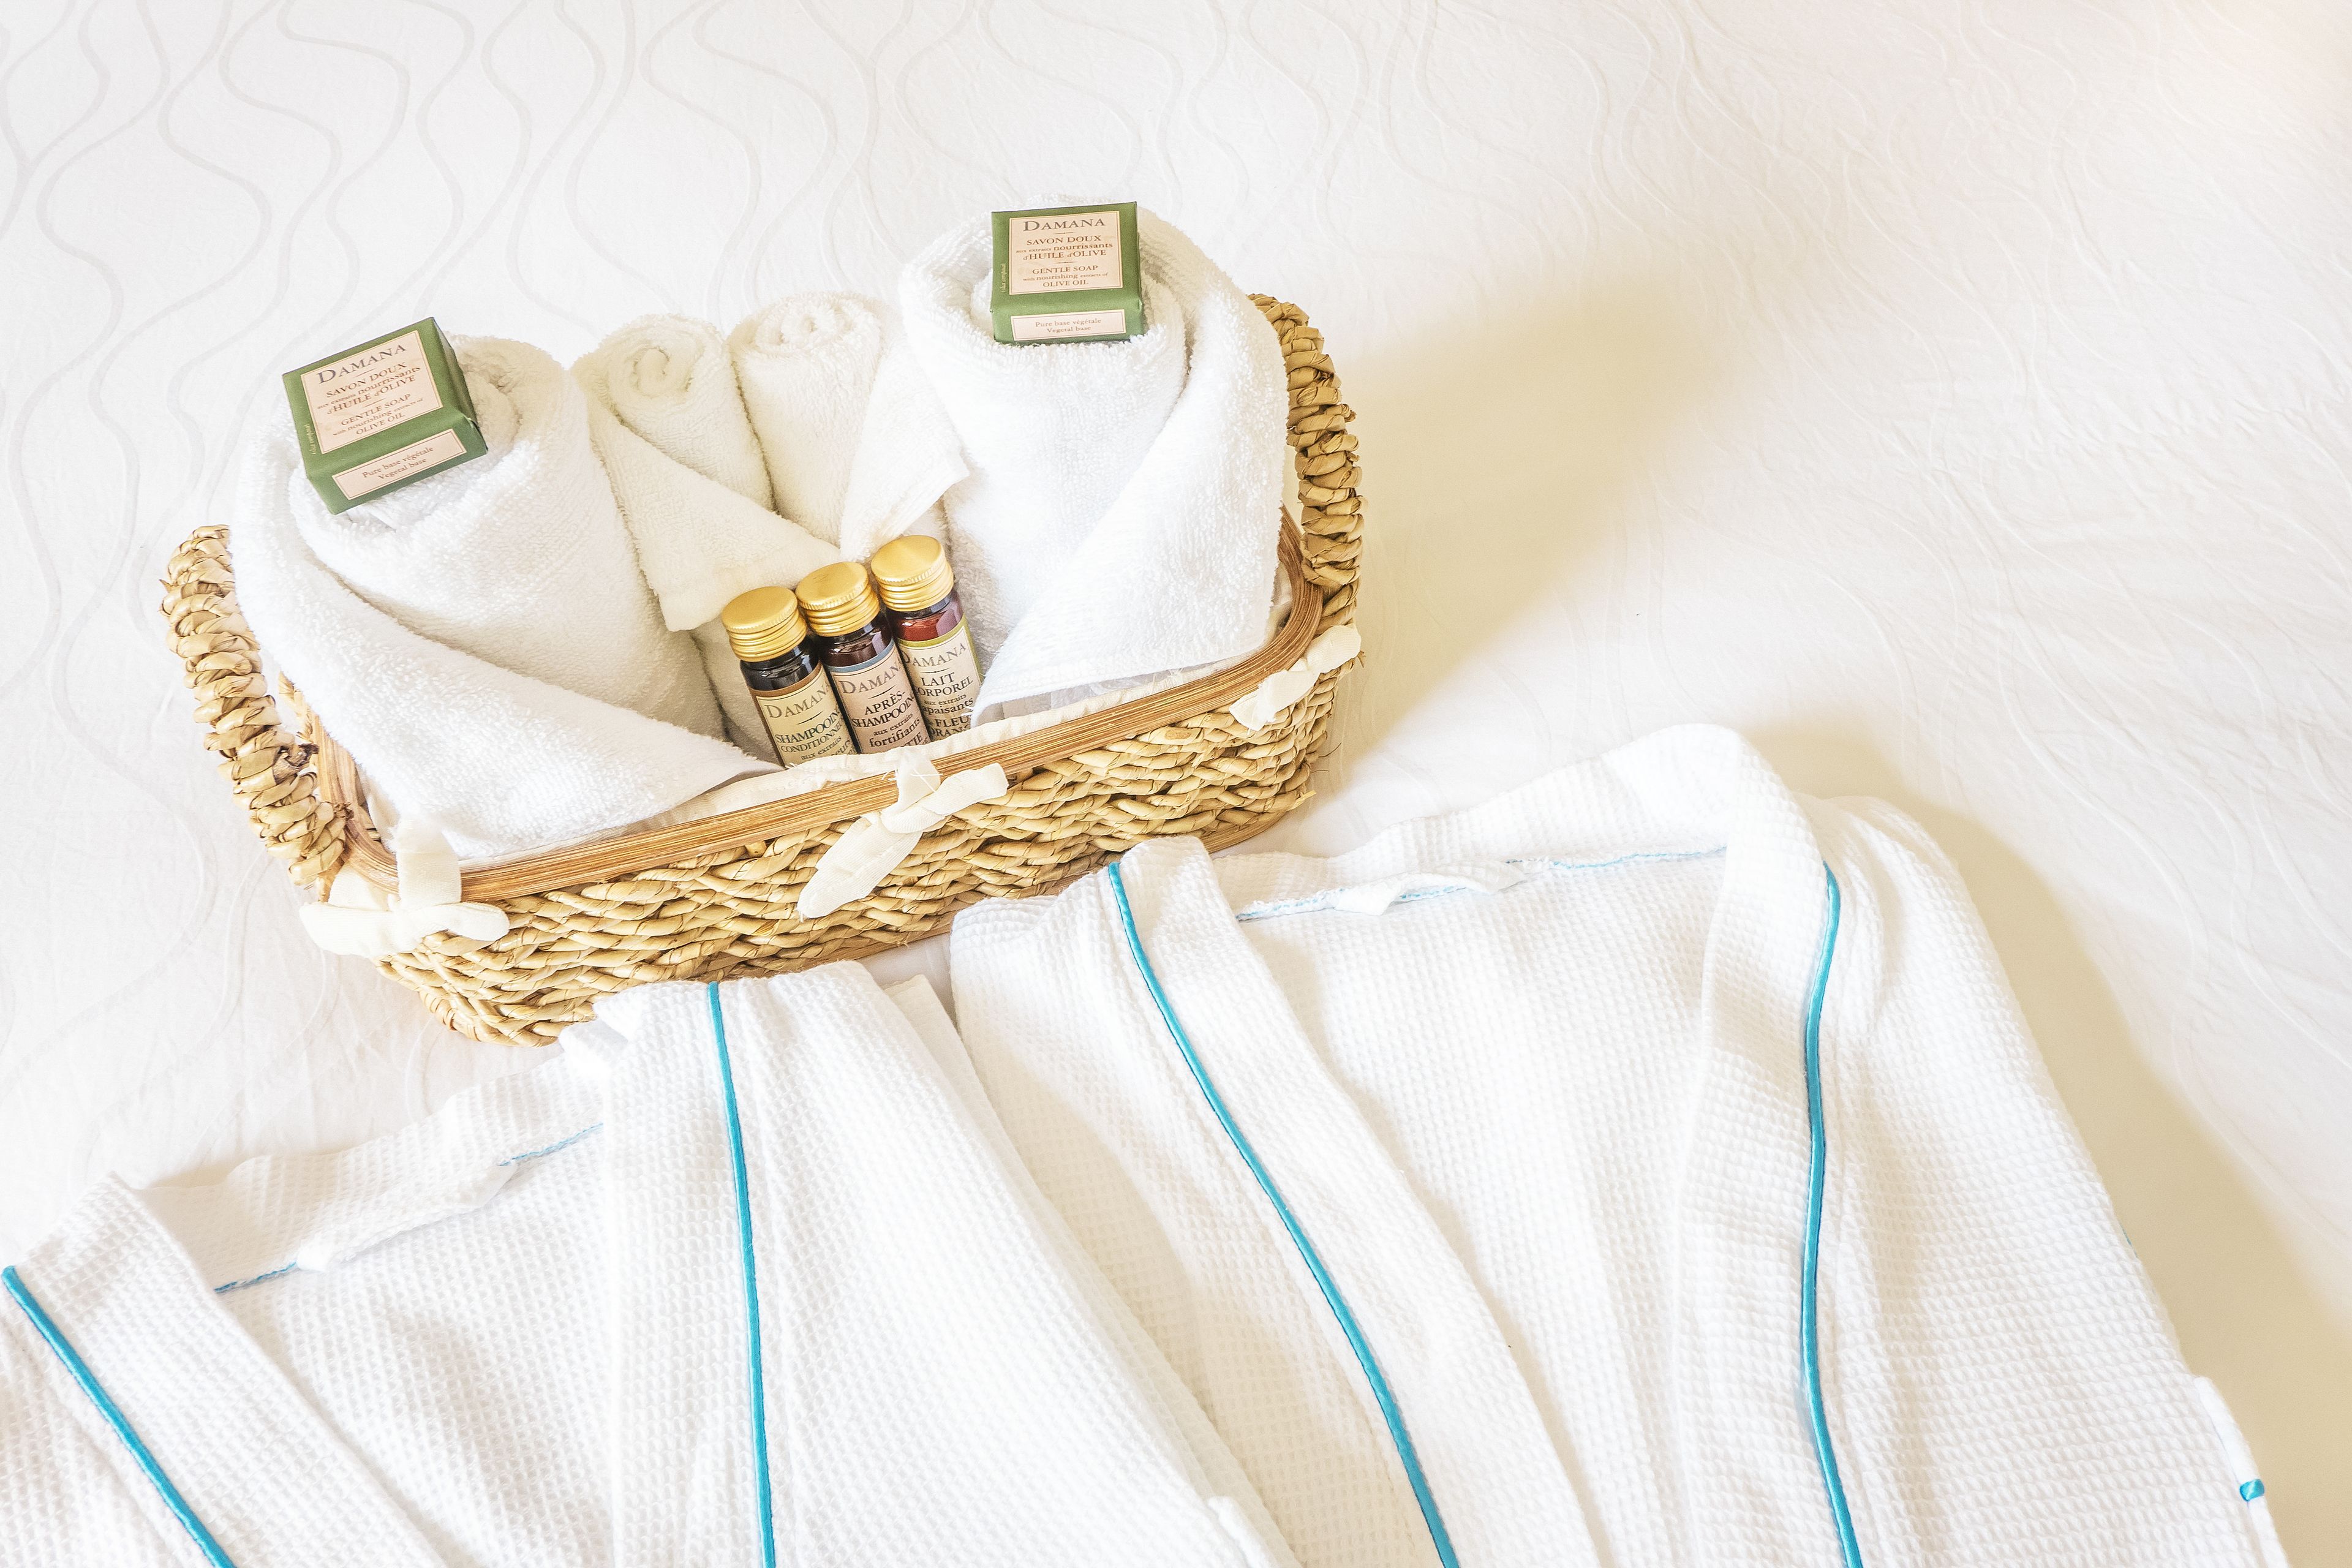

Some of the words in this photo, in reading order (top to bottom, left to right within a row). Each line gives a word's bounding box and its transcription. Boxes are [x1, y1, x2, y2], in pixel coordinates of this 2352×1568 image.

[1023, 218, 1105, 232] DAMANA
[1027, 237, 1063, 246] SAVON
[1023, 252, 1064, 260] d'HUILE
[317, 344, 407, 384] DAMANA
[326, 379, 366, 398] SAVON
[369, 362, 407, 382] DOUX
[358, 367, 421, 394] nourrissants
[327, 393, 371, 415] d'HUILE
[374, 375, 416, 397] d'OLIVE
[341, 405, 382, 426] GENTLE
[385, 394, 411, 409] SOAP
[348, 410, 392, 431] nourishing
[356, 419, 386, 435] OLIVE
[388, 412, 405, 423] OIL
[362, 468, 382, 478] Pure
[382, 460, 401, 470] base
[377, 465, 408, 479] Vegetal
[409, 459, 426, 468] base
[916, 676, 973, 697] ORPOREL
[920, 672, 956, 687] LAIT
[851, 693, 914, 728] SHAMPOOIN
[865, 690, 905, 715] APRÈS-
[938, 694, 967, 706] extraits
[775, 706, 840, 743] SHAMPOOIN
[889, 712, 913, 731] extraits
[935, 715, 971, 728] FLEU
[781, 721, 842, 753] CONDITIONNE
